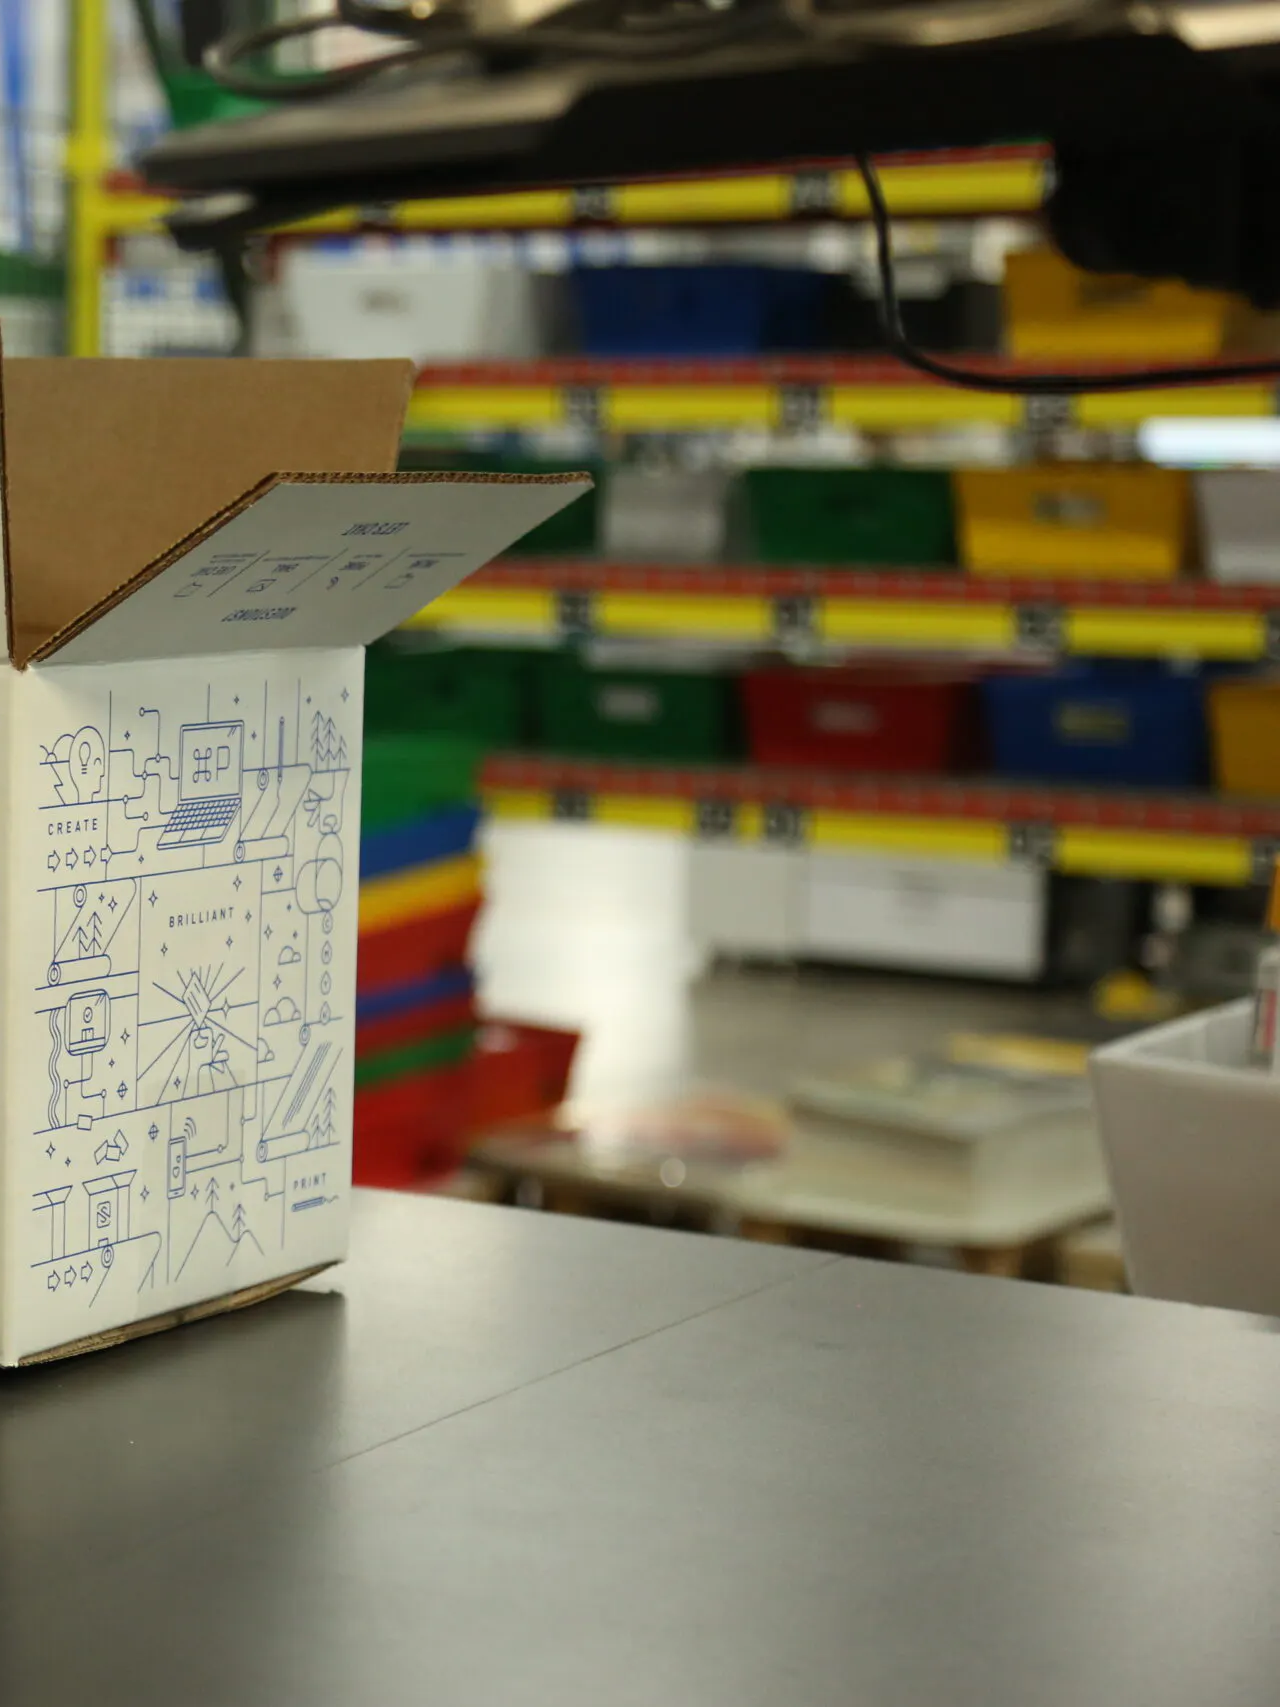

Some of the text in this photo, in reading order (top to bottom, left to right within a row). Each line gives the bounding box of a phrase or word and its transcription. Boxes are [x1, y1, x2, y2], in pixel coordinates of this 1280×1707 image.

[47, 818, 98, 836] CREATE
[169, 906, 234, 928] BRILLIANT
[293, 1172, 326, 1190] PRINT
